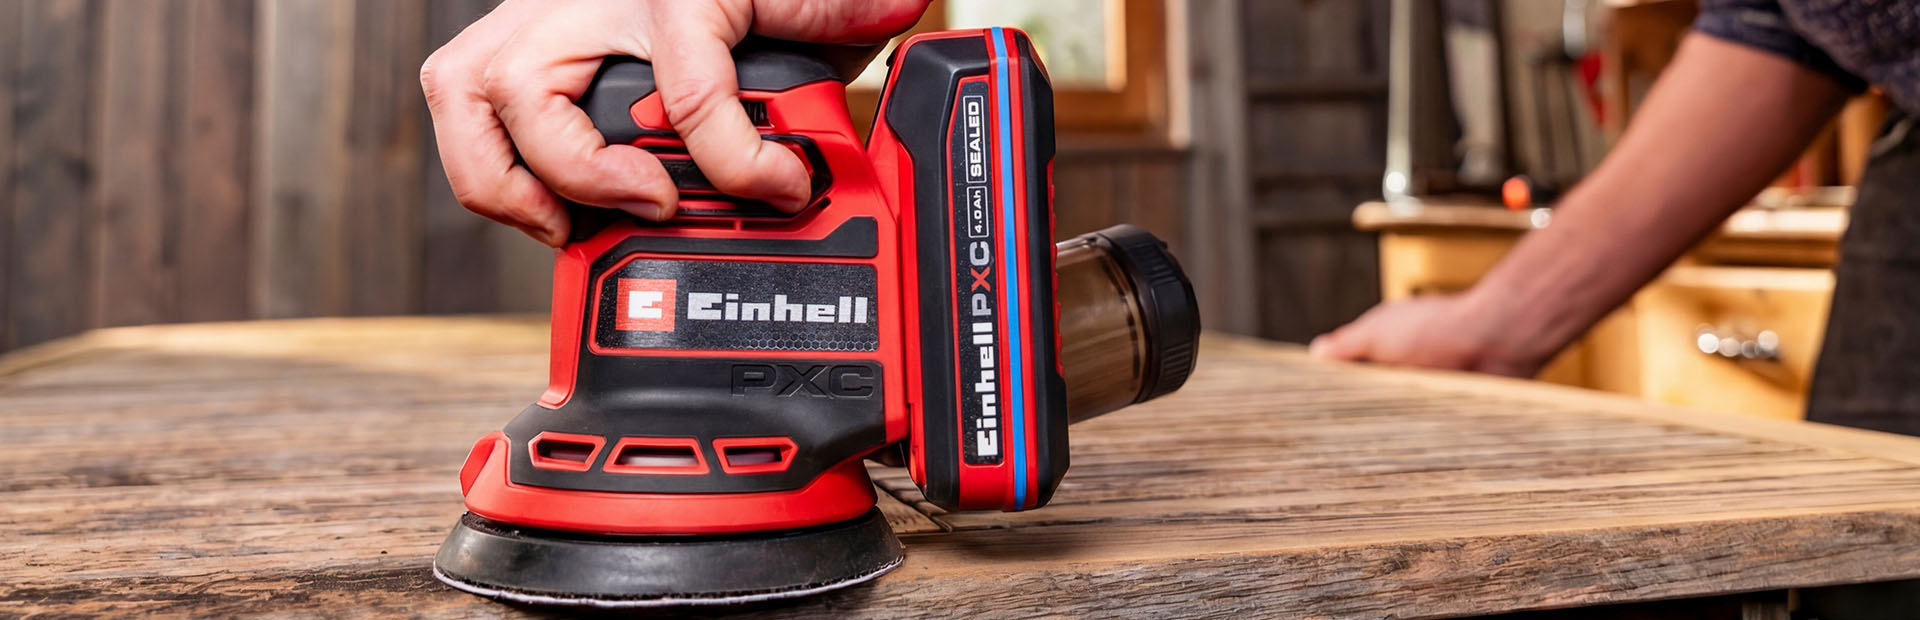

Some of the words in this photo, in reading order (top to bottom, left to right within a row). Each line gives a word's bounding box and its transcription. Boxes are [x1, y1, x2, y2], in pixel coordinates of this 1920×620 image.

[968, 101, 983, 177] SEALED
[973, 189, 984, 234] 4.0Ah
[687, 292, 869, 324] Einhell
[970, 241, 992, 316] PXC
[730, 363, 875, 398] PXC
[972, 323, 999, 457] Einhell
